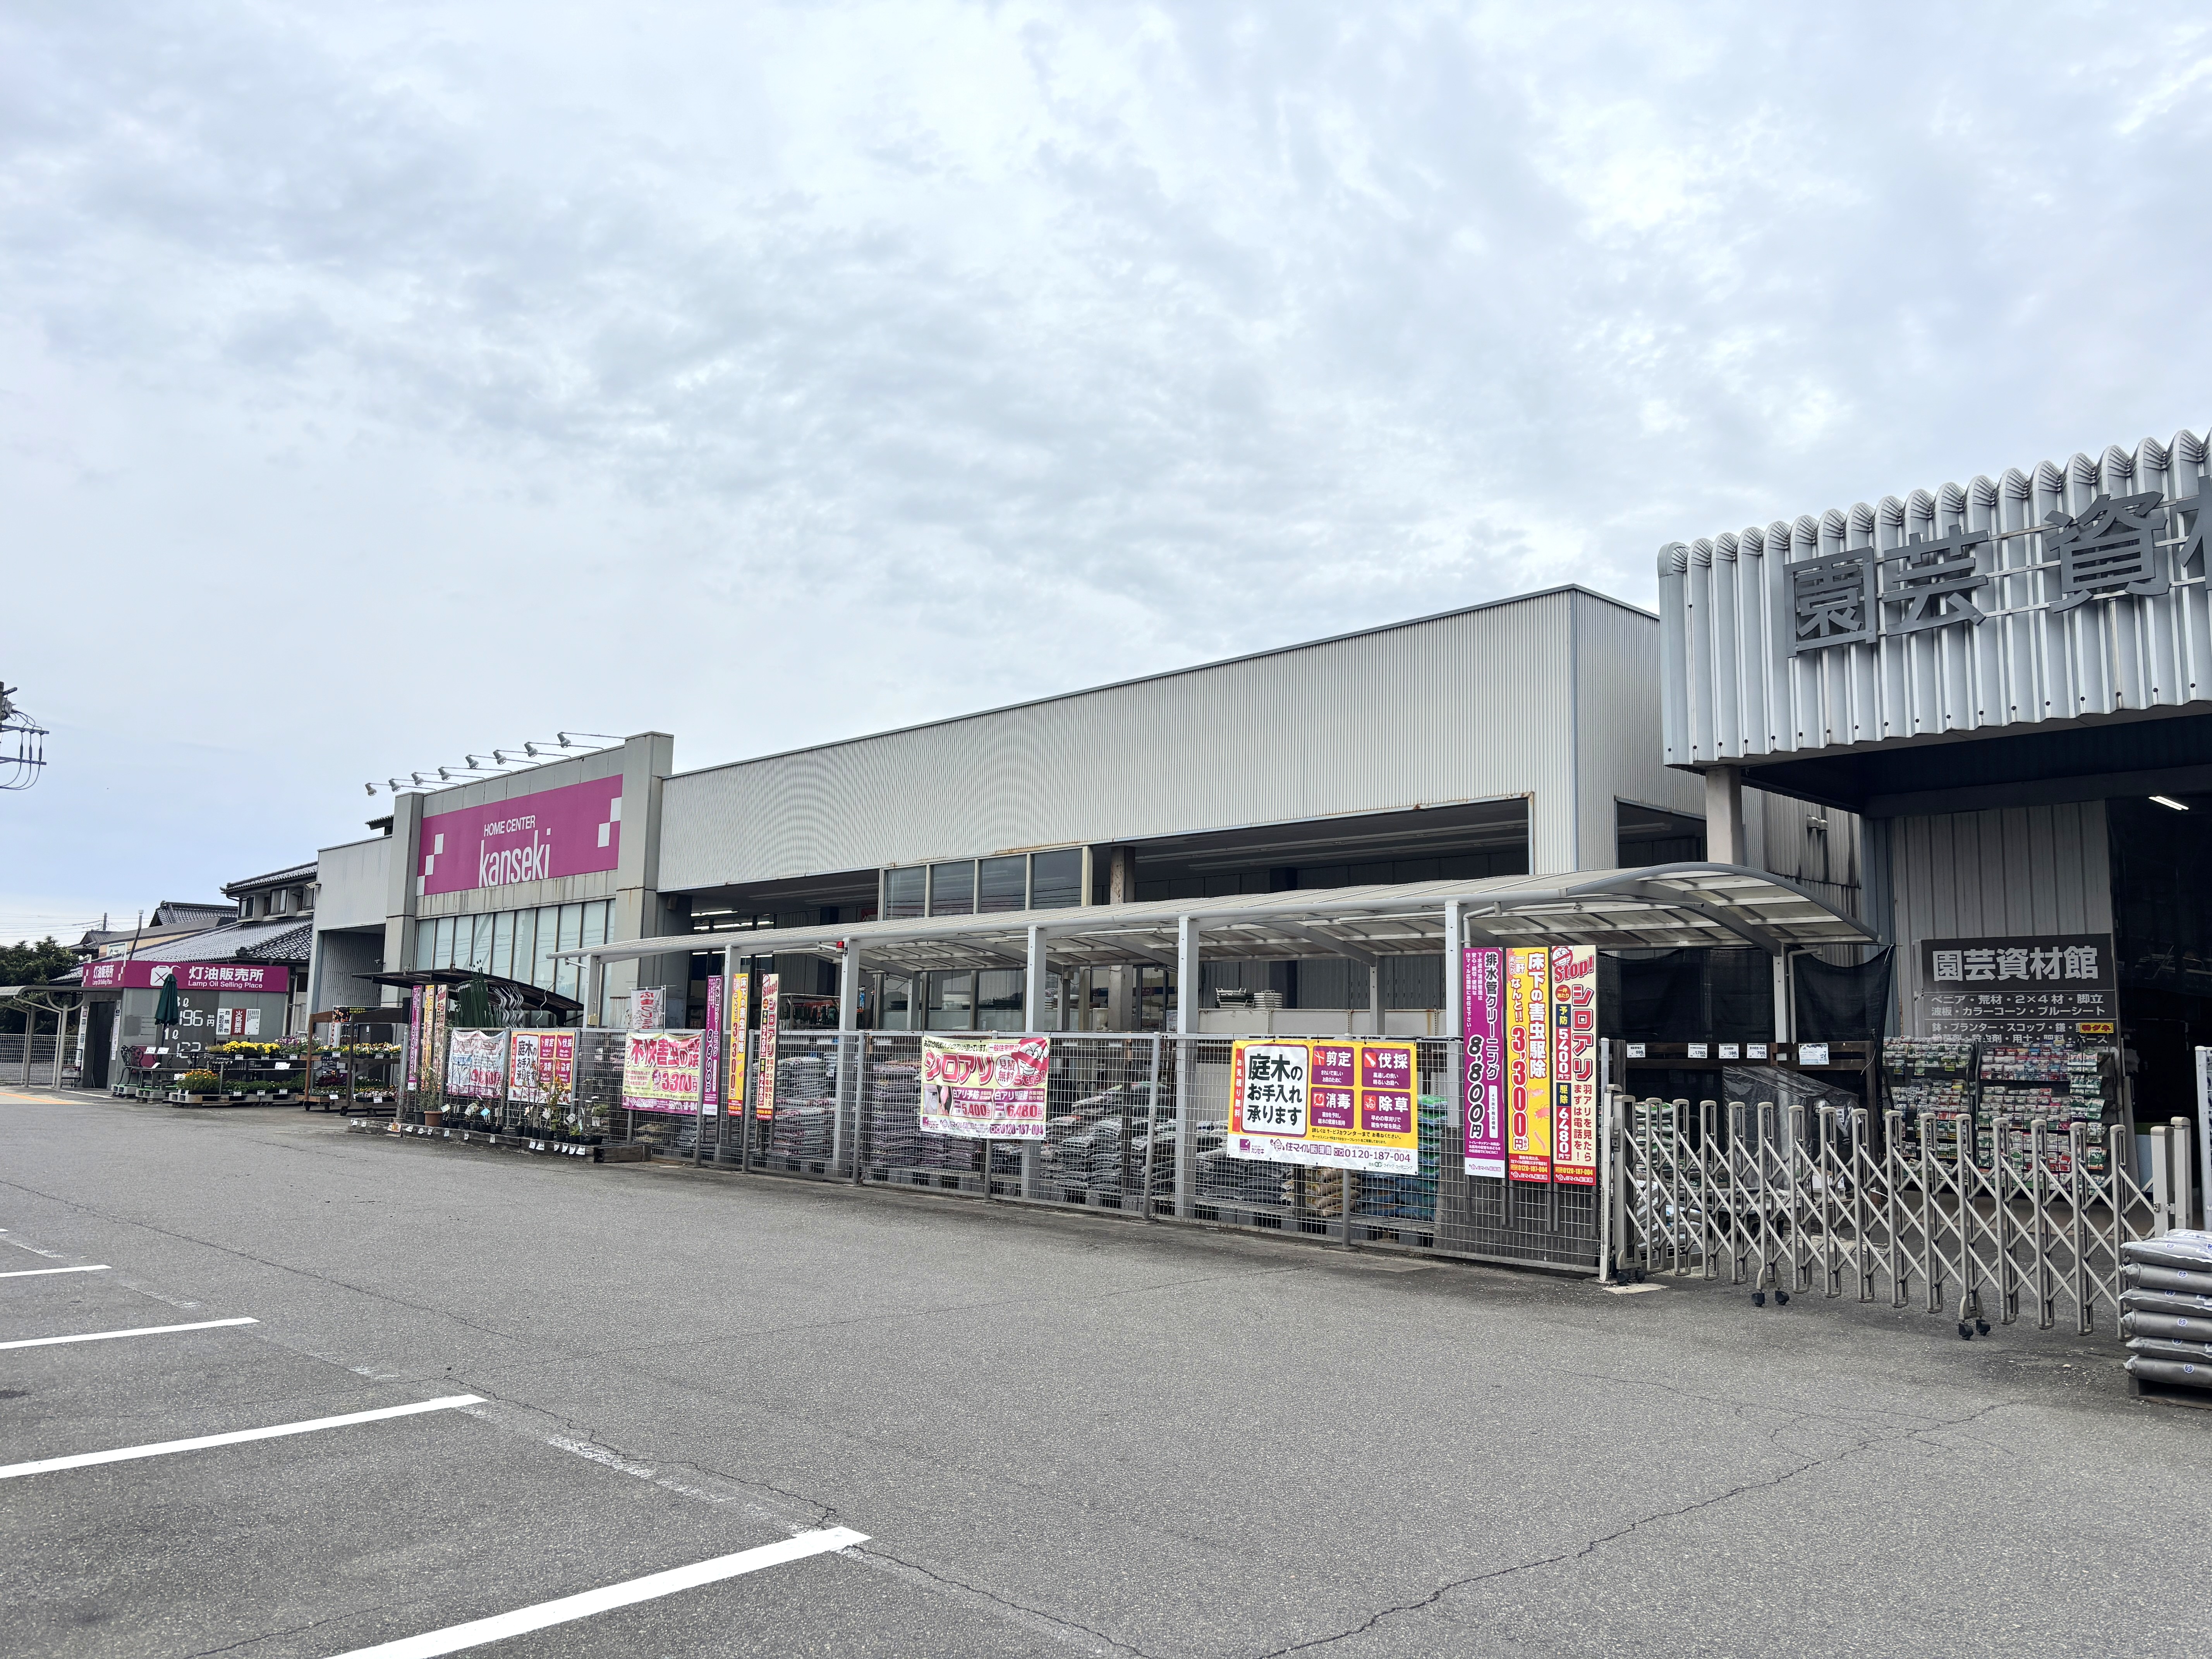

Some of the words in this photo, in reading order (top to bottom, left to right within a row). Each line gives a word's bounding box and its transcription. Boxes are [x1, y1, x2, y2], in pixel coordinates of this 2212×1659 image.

[484, 820, 505, 836] HOME
[506, 815, 536, 833] CENTER
[478, 828, 551, 888] kanseki
[1554, 955, 1594, 983] Stop!
[1933, 945, 2099, 981] 園芸資材館
[189, 966, 264, 982] 灯油販売所
[1485, 952, 1499, 1080] 排水管クリーニング
[1528, 952, 1547, 1079] 床下の害虫駆除
[1559, 1006, 1568, 1025] 予防
[767, 998, 776, 1057] シロアリ
[1572, 984, 1594, 1082] シロアリ
[518, 1040, 537, 1056] 庭木の
[924, 1052, 994, 1086] シロアリ
[999, 1059, 1016, 1071] 見積
[1248, 1053, 1303, 1082] 庭木の
[1326, 1051, 1351, 1067] 剪定
[1378, 1053, 1408, 1069] 伐採
[998, 1072, 1014, 1082] 無料
[1013, 1070, 1046, 1087] Stop!
[1467, 1034, 1485, 1139] 8,800円
[953, 1089, 980, 1100] 白アリ予防
[995, 1090, 1028, 1101] 白アリ駆除
[1234, 1059, 1242, 1118] お見積り無料
[1247, 1083, 1302, 1103] お手入れ
[1559, 1085, 1568, 1104] 駆除
[1326, 1092, 1351, 1109] 消毒
[1379, 1096, 1408, 1113] 除草
[1247, 1105, 1302, 1126] 承ります
[1574, 1085, 1582, 1161] まずは電話を!
[1583, 1085, 1592, 1162] 羽アリを見たら
[1345, 1149, 1411, 1162] 0120-187-004
